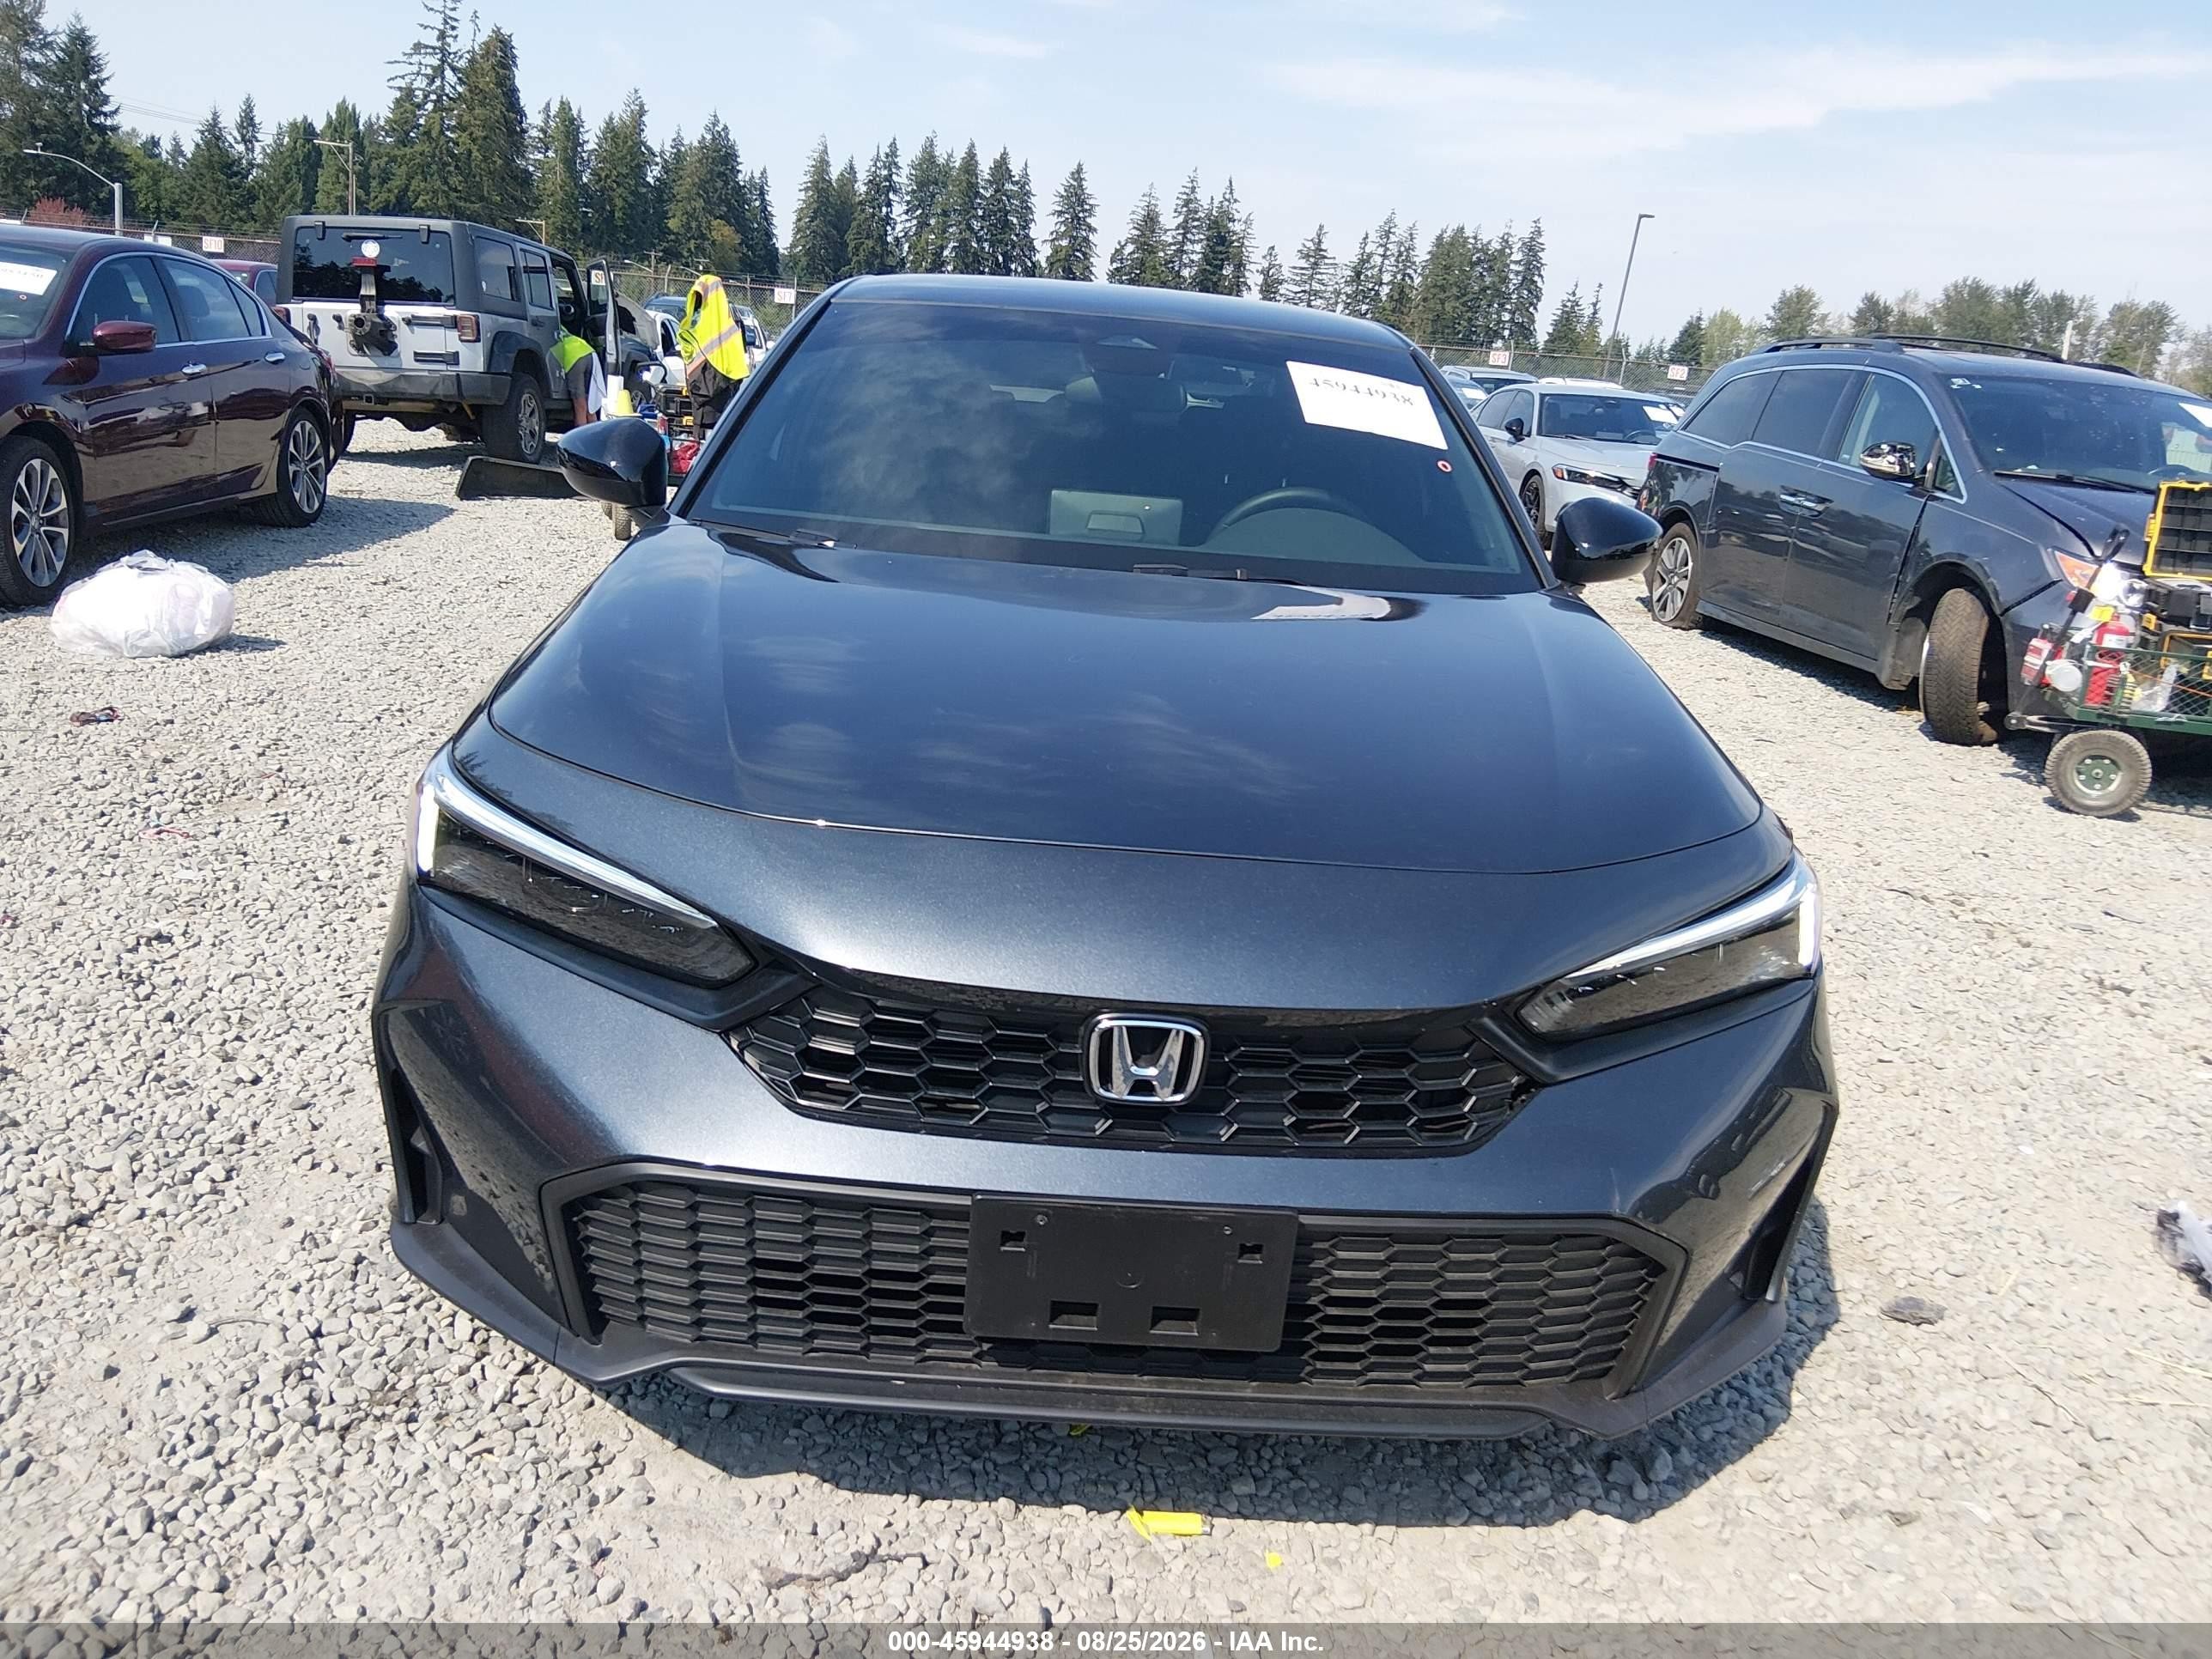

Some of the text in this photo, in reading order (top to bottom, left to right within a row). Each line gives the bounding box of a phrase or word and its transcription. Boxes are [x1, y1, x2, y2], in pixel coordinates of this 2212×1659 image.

[204, 238, 222, 250] SF10
[777, 290, 793, 302] SF7
[1492, 353, 1507, 364] SF3
[1669, 367, 1686, 379] SF2
